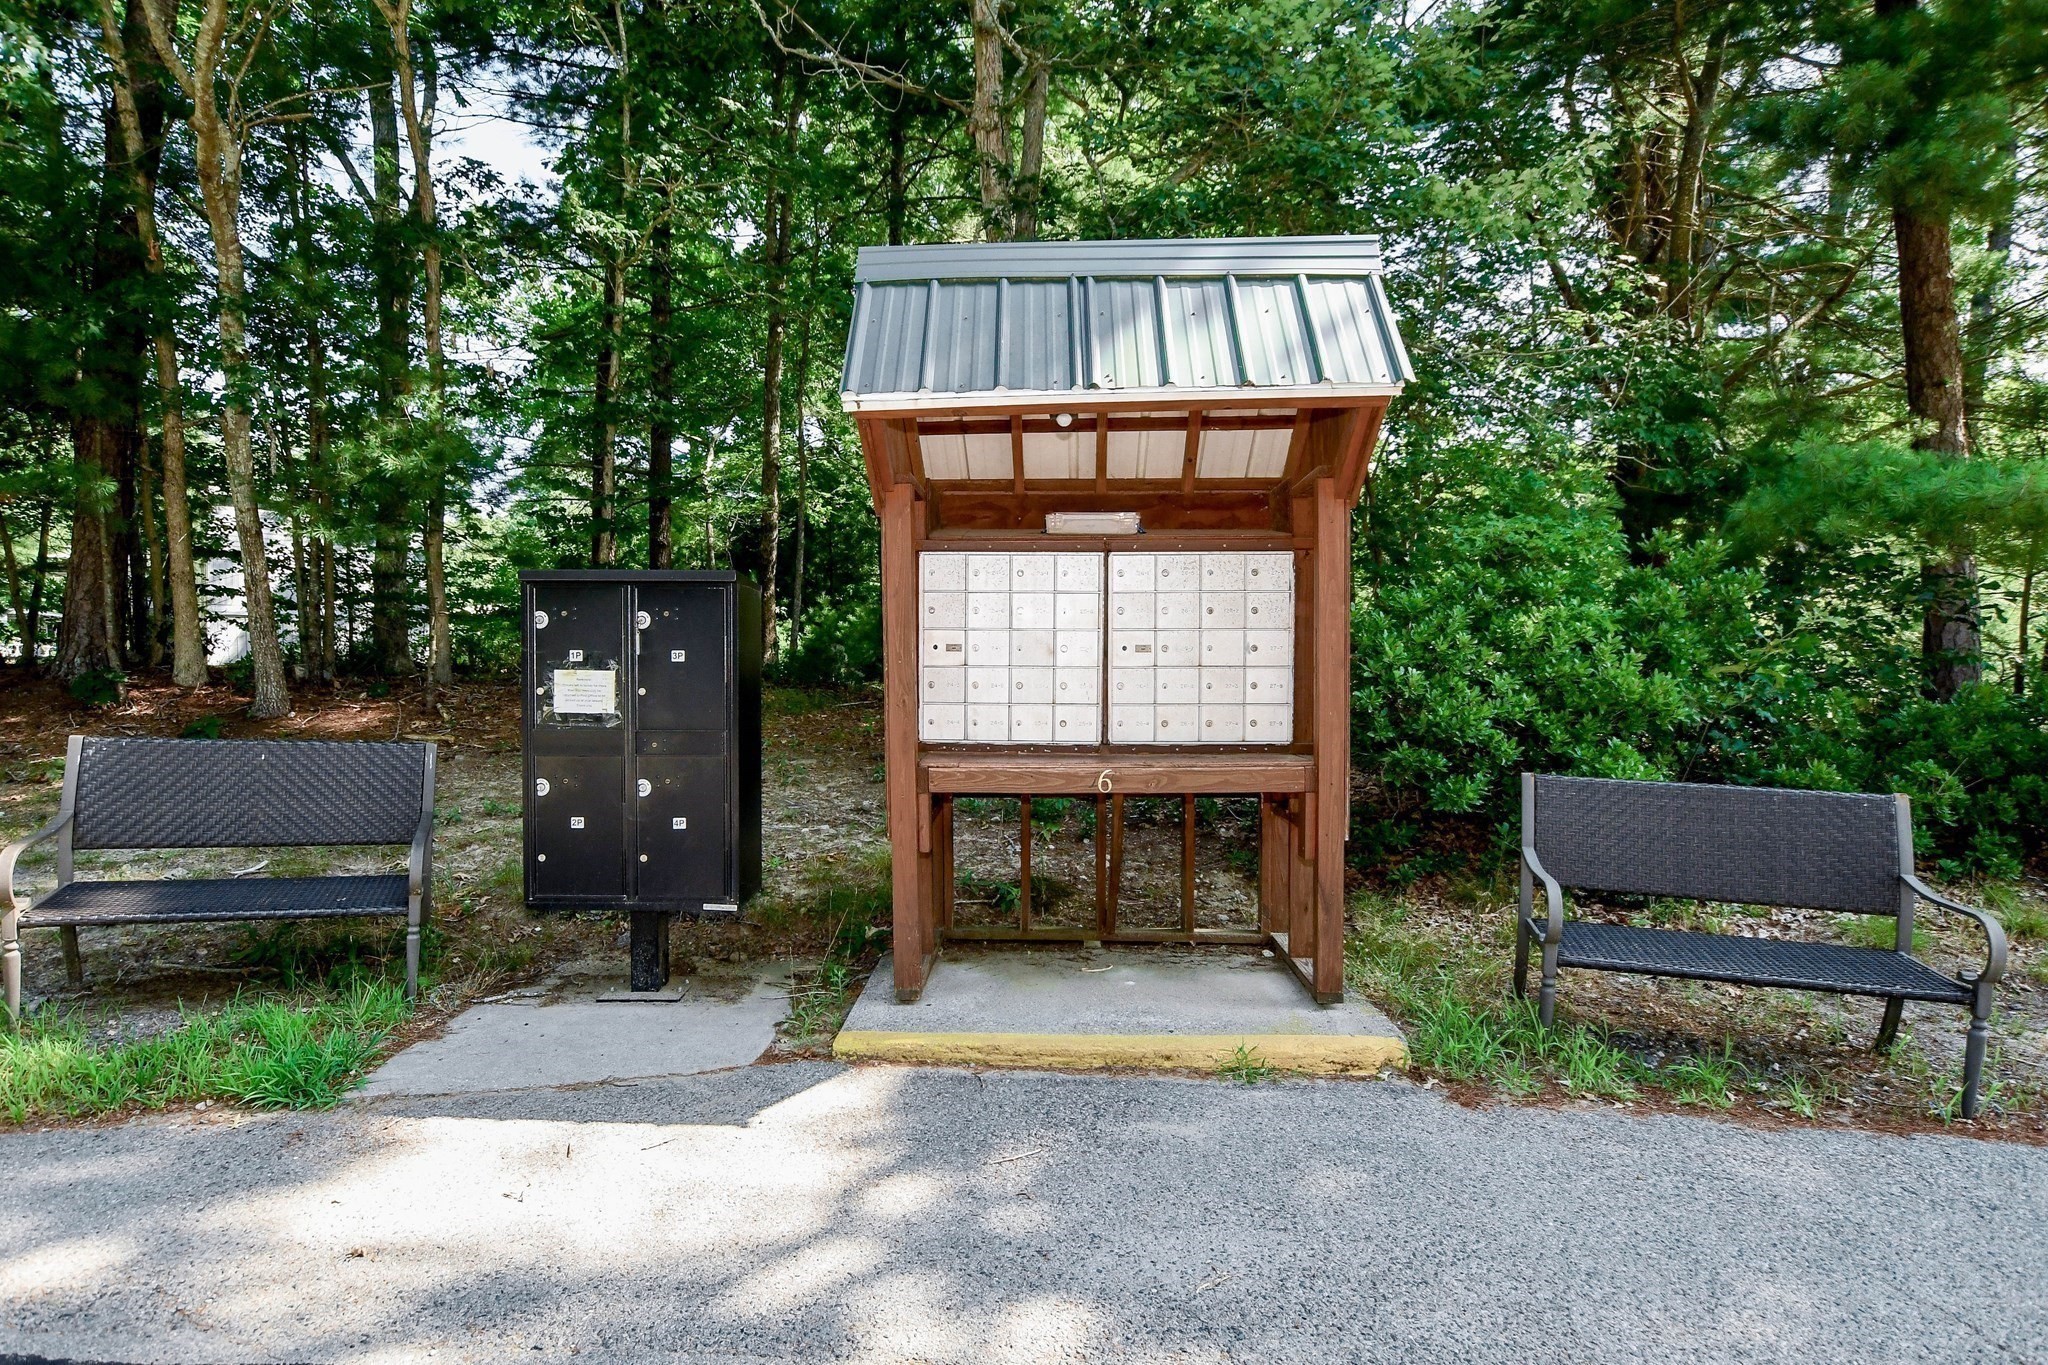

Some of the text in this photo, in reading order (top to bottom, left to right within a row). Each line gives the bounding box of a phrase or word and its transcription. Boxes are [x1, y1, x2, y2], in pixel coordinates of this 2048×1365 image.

[571, 652, 582, 660] 1P
[672, 652, 684, 660] 3P
[1098, 769, 1114, 793] 6
[571, 818, 583, 827] 2P
[673, 819, 685, 827] 4P
